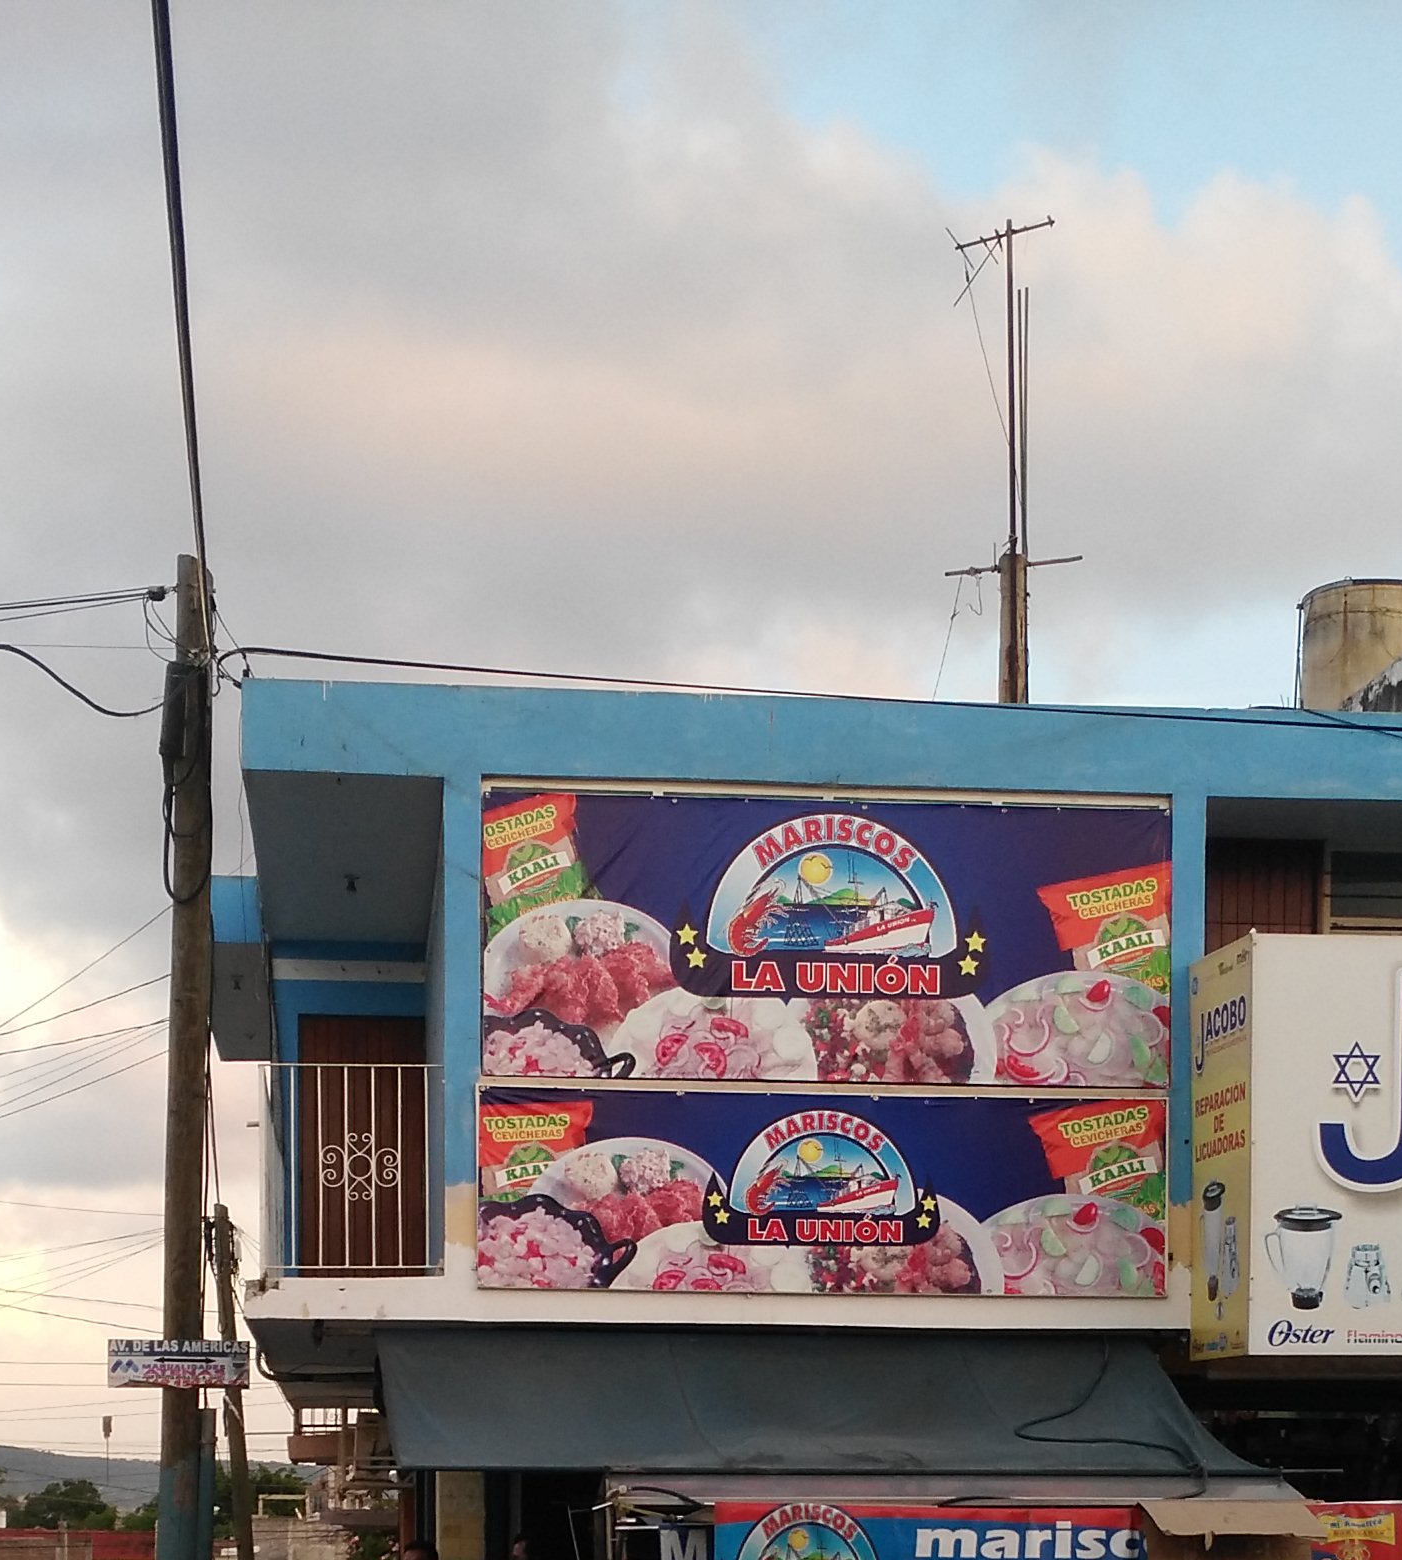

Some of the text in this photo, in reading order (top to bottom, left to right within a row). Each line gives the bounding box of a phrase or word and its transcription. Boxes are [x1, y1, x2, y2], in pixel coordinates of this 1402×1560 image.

[485, 806, 555, 837] OSTADAS
[488, 821, 552, 847] CEVICHERAS
[754, 816, 917, 870] MARISCOS
[507, 855, 559, 885] KAALI
[1069, 880, 1156, 907] TOSTADAS
[1081, 895, 1151, 916] CEVICHERAS
[1098, 933, 1154, 960] KAALI
[732, 955, 940, 994] LA UNIÓN
[1195, 996, 1246, 1071] JACOBO
[1195, 1081, 1246, 1118] REPARACIÓN
[485, 1116, 568, 1129] TOSTADAS
[495, 1129, 562, 1140] CEVICHERAS
[764, 1113, 885, 1151] MARISCOS
[1060, 1108, 1147, 1136] TOSTADAS
[1072, 1123, 1142, 1145] CEVICHERAS
[1213, 1114, 1224, 1133] DE
[1195, 1130, 1245, 1162] LICUADORAS
[505, 1164, 548, 1181] KAA
[1089, 1160, 1146, 1188] KAALI
[748, 1213, 903, 1243] LA UNIÓN
[109, 1339, 248, 1353] AV. DE LAS AMERICAS
[1268, 1320, 1334, 1346] Oster
[762, 1504, 857, 1540] MARISCOS
[915, 1522, 1148, 1560] marisc
